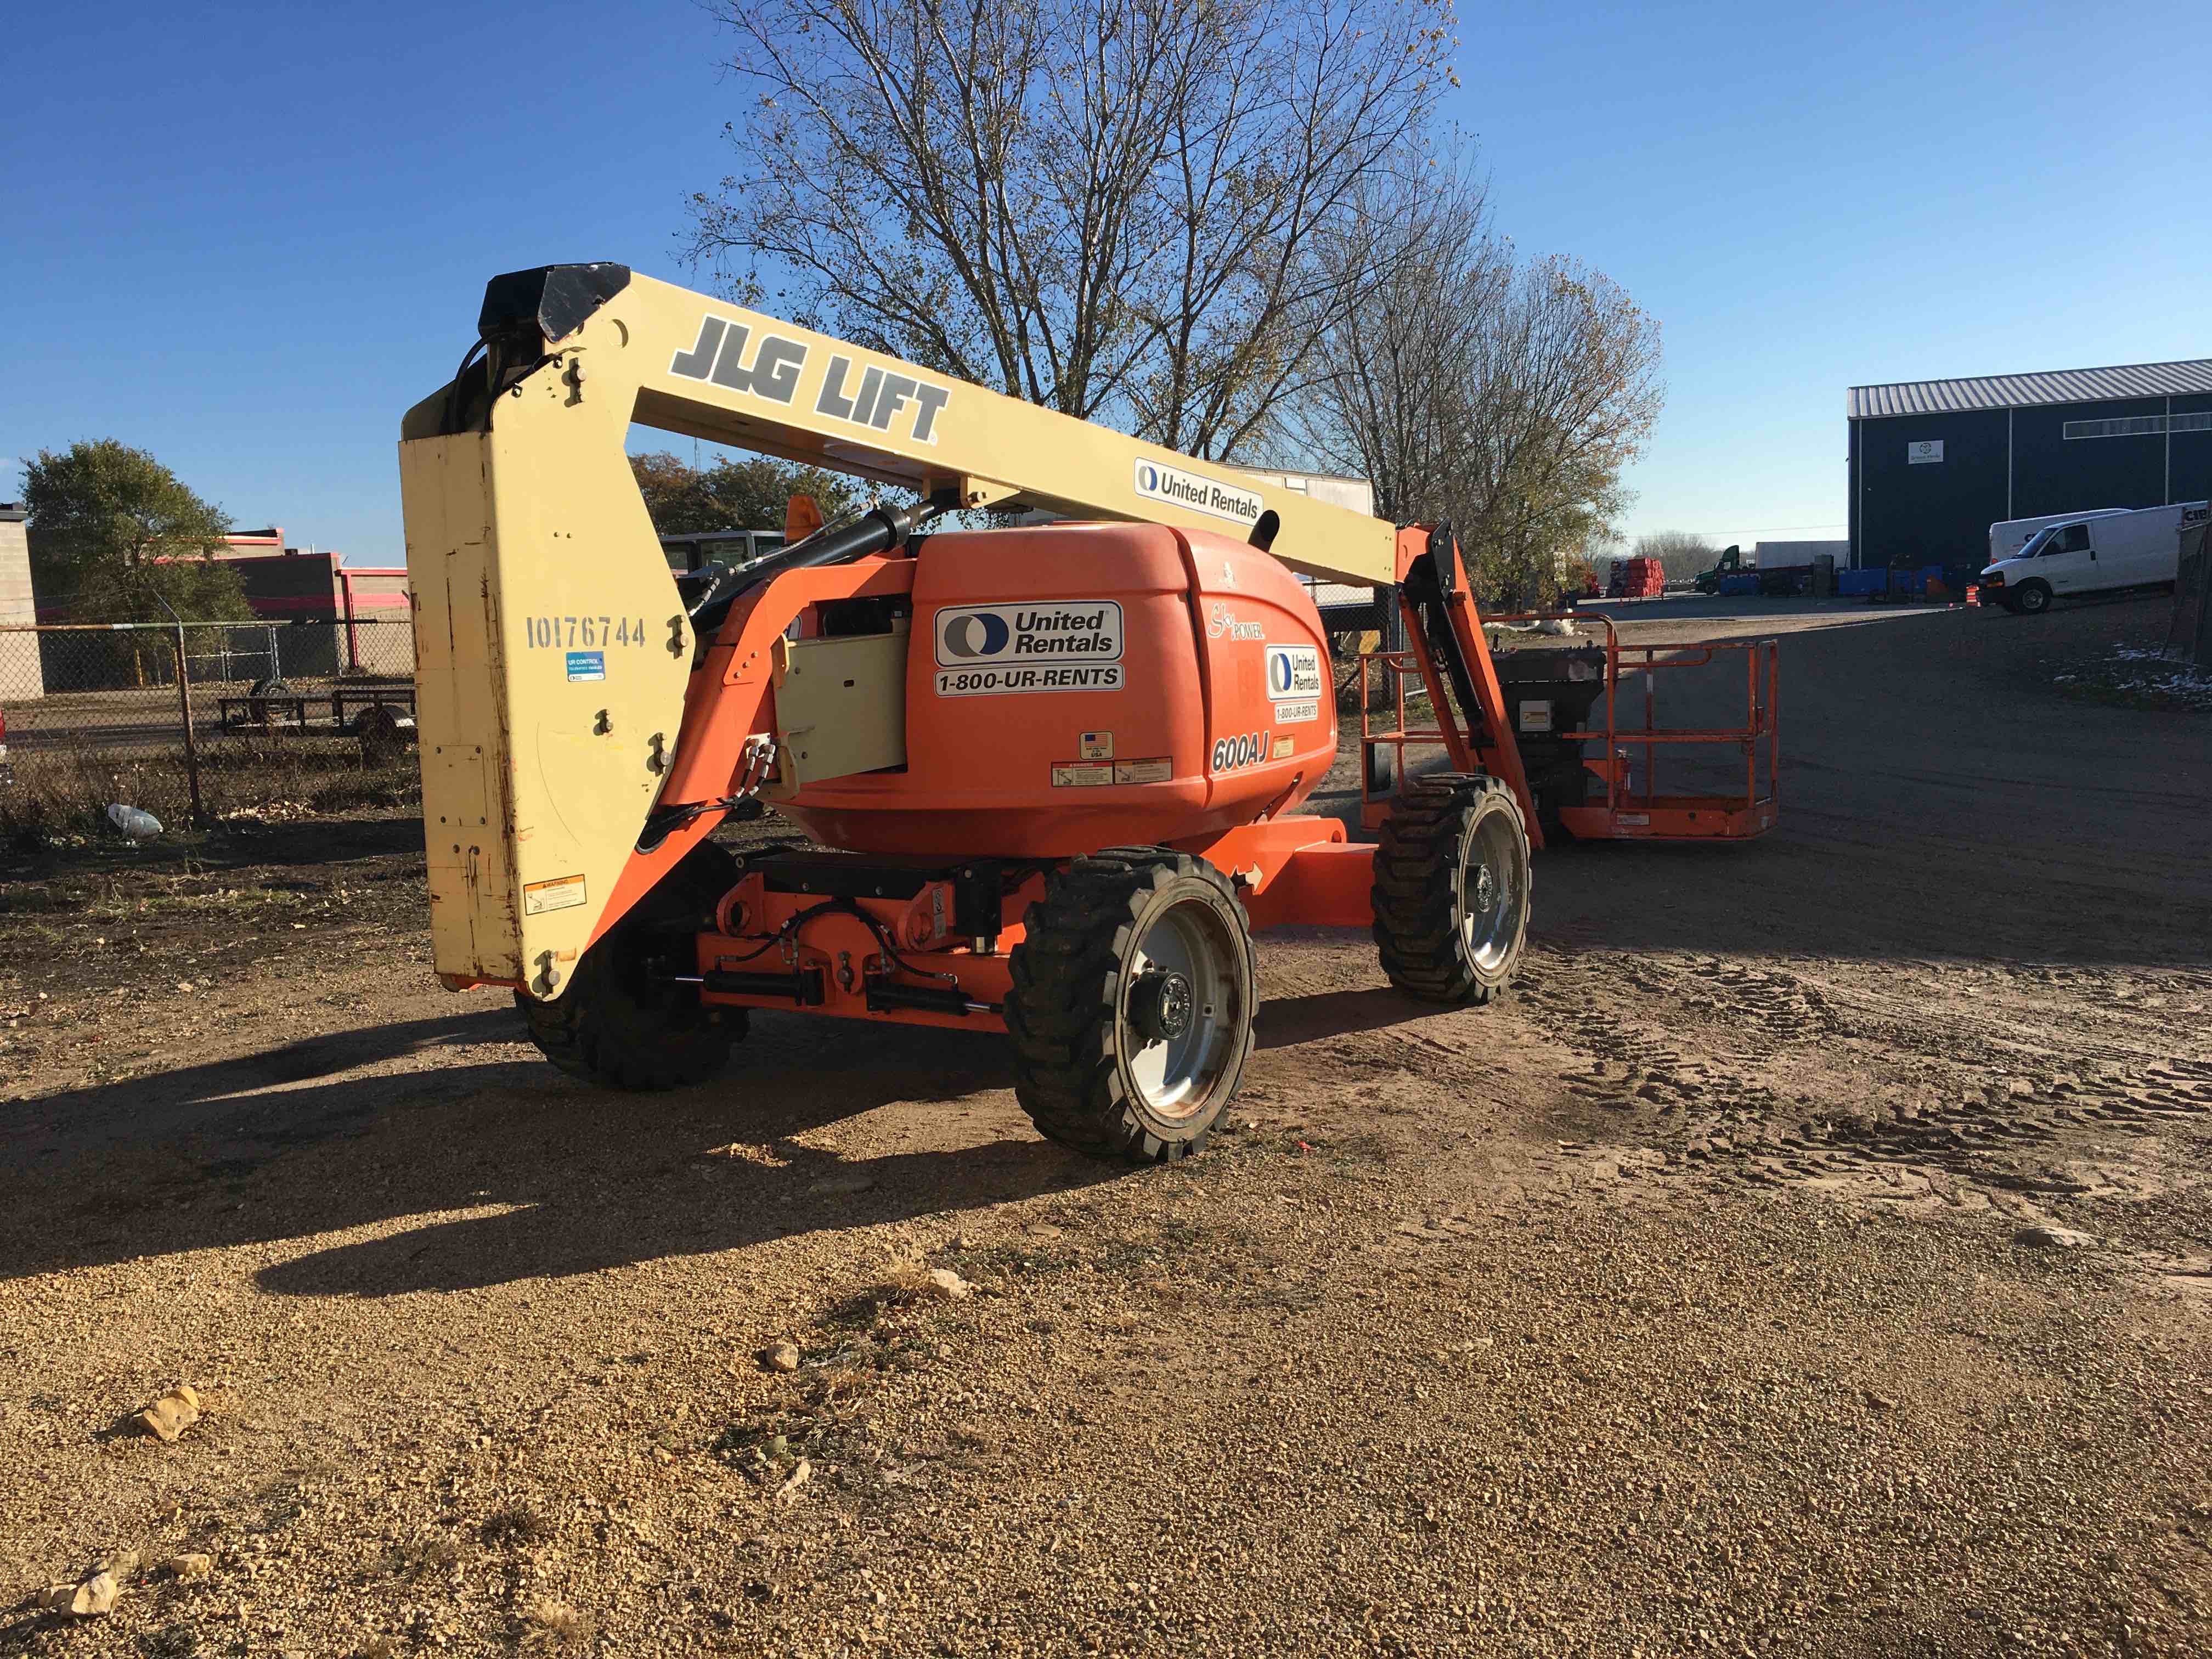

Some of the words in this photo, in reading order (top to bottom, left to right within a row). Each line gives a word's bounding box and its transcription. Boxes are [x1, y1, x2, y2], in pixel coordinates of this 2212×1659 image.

[668, 313, 810, 406] JLG
[814, 353, 952, 442] LIFT
[1161, 472, 1208, 505] United
[1210, 487, 1258, 520] Rentals
[1014, 610, 1105, 631] United
[526, 617, 645, 648] 10176744
[1014, 633, 1112, 654] Rentals
[1292, 654, 1315, 671] United
[939, 668, 1118, 691] 1-800-UR-RENTS
[1294, 674, 1319, 691] Rentals
[1277, 705, 1317, 719] 1-800-UR-RENTS
[1212, 730, 1270, 772] 600AJ
